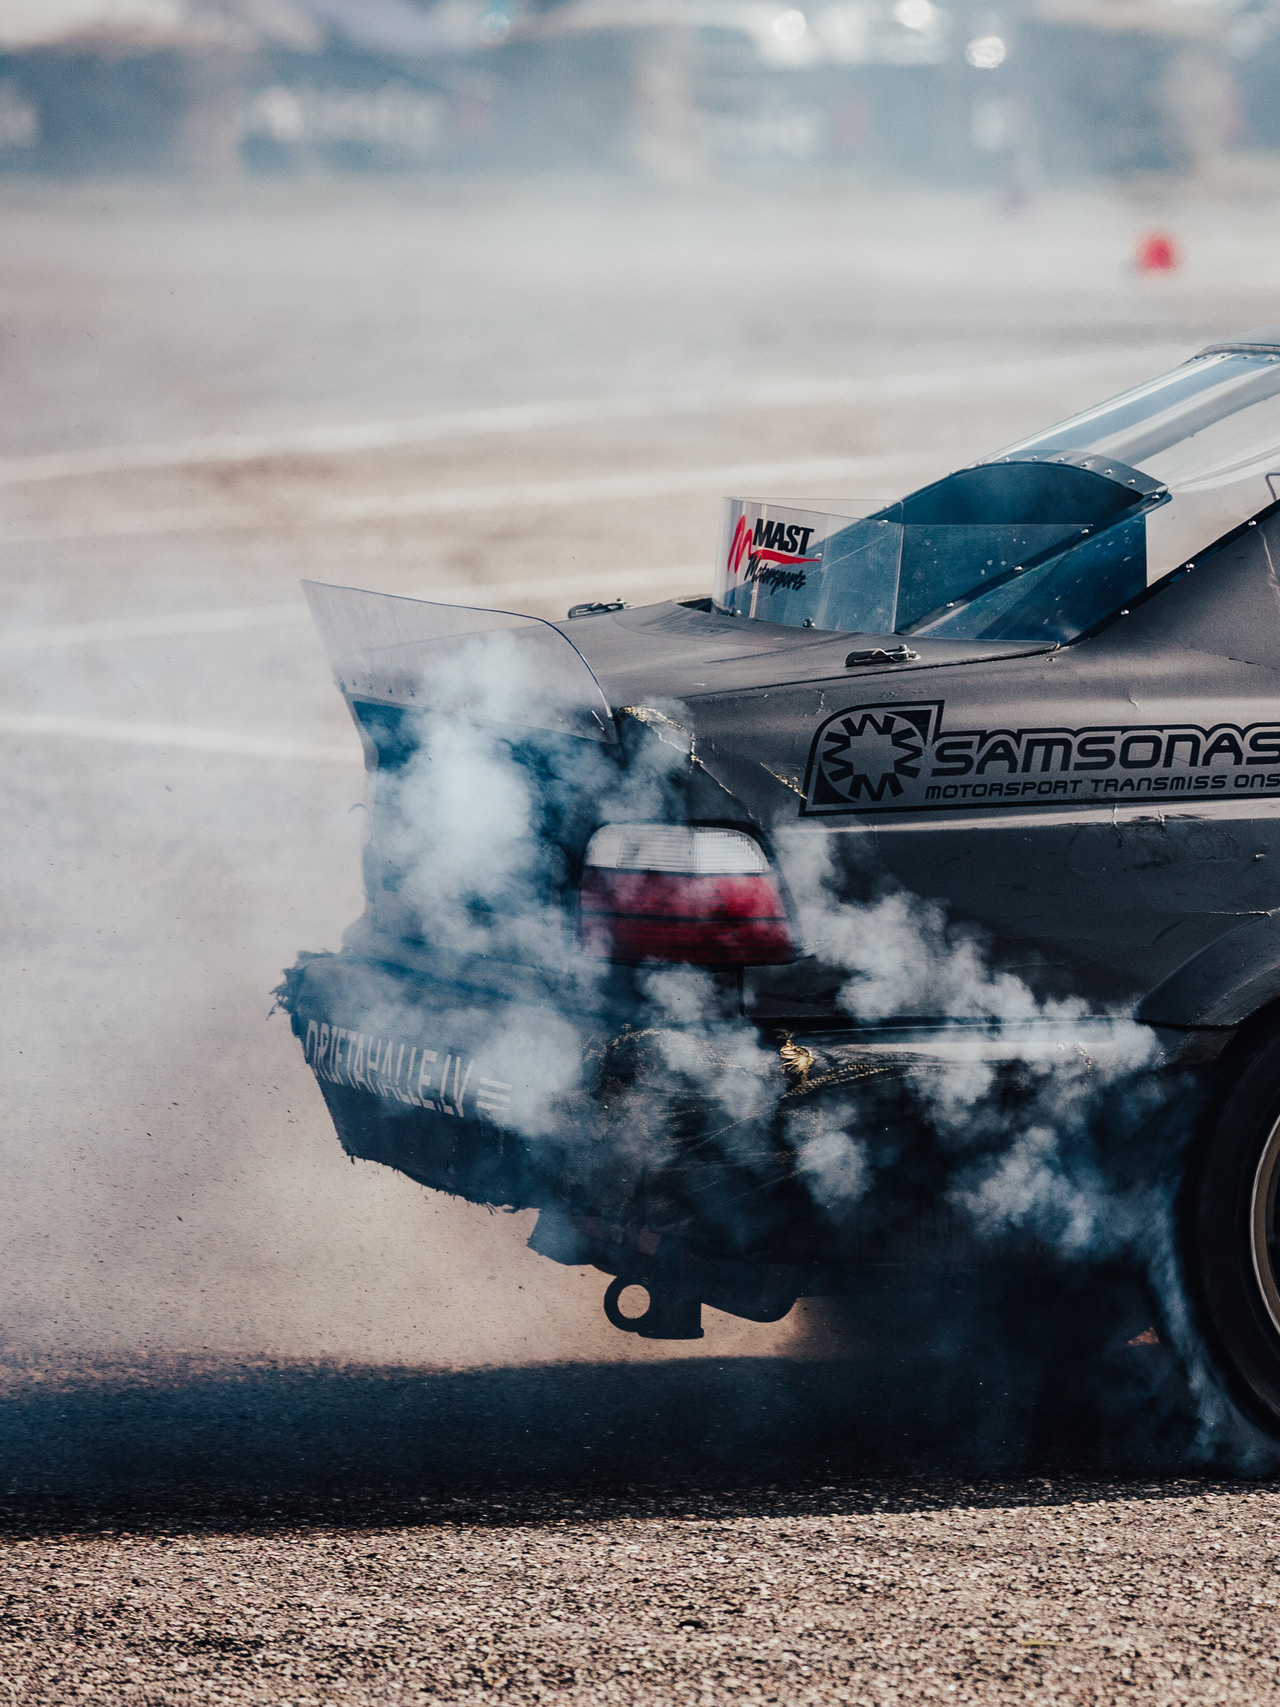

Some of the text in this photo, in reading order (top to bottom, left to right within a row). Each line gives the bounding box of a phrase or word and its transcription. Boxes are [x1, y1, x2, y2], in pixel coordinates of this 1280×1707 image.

[752, 518, 815, 555] MAST
[744, 555, 807, 596] Motorsports
[924, 779, 1082, 800] MOTORSPORT
[305, 1019, 475, 1118] DRIFTAHALLE.LV
